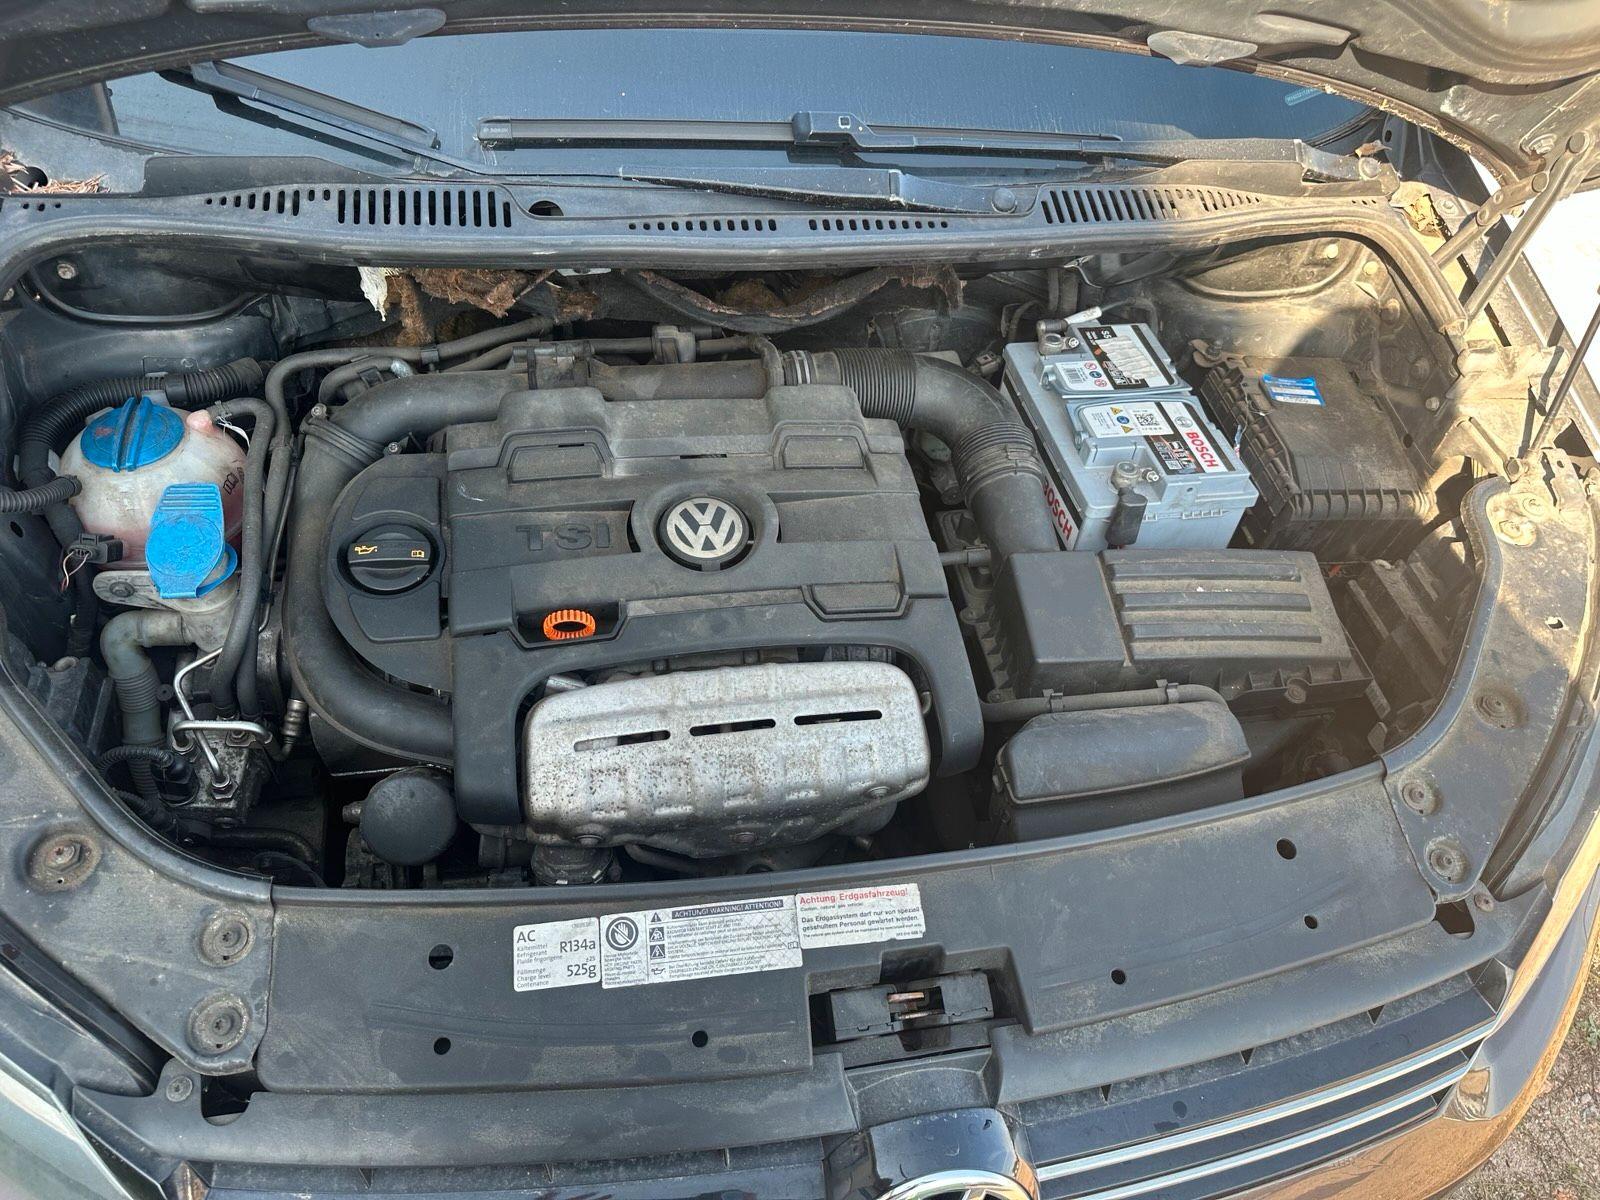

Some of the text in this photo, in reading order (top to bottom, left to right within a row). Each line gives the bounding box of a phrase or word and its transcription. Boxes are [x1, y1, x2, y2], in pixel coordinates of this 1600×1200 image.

[1185, 432, 1219, 467] BOSCH
[516, 523, 610, 550] TSI
[839, 888, 908, 901] Erdgasfahrzeug!
[710, 905, 743, 914] WARNING!
[803, 923, 838, 932] geschultem
[840, 919, 866, 928] Personal
[868, 917, 894, 926] gewartet
[816, 913, 858, 922] Erdgassystem
[516, 930, 536, 943] AC
[559, 938, 596, 953] R134a
[566, 963, 597, 979] 525g
